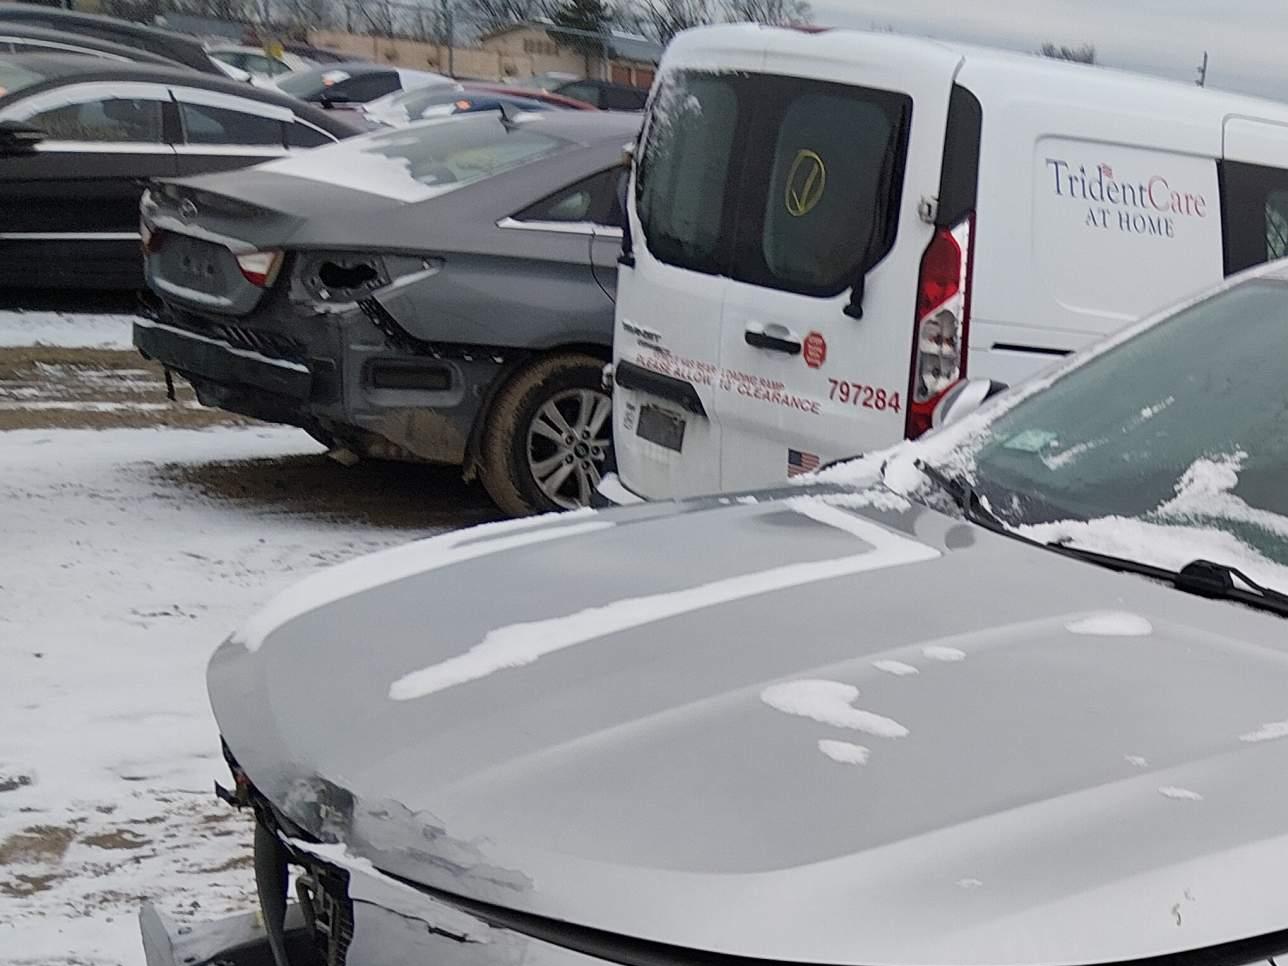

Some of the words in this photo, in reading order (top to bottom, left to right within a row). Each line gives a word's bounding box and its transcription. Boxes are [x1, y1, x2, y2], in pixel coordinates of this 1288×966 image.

[1045, 158, 1207, 218] TridentCare
[1086, 207, 1111, 229] AT
[1118, 210, 1175, 238] HOME
[737, 382, 823, 415] CLEARANCE
[827, 377, 901, 414] 797284
